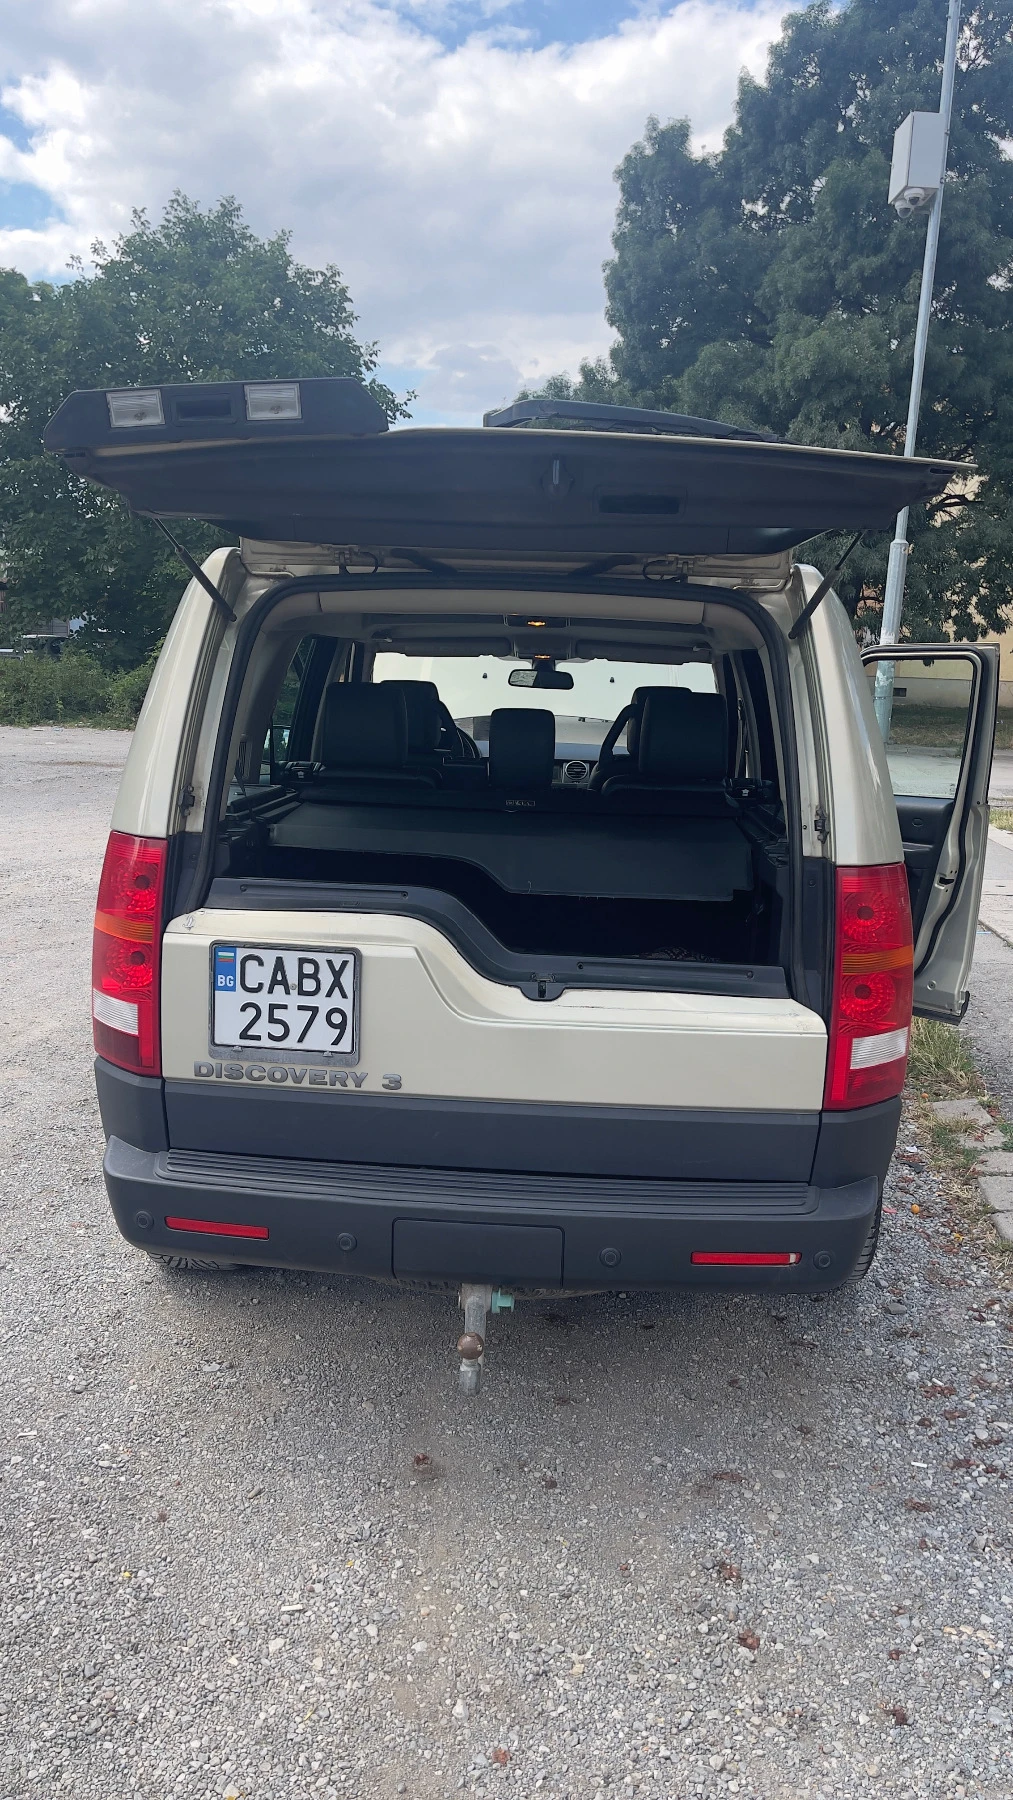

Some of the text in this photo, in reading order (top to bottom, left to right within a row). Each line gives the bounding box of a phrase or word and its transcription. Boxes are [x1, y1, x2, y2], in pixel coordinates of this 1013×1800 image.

[217, 974, 234, 987] BG
[239, 953, 349, 999] CABX
[239, 1001, 348, 1046] 2579
[193, 1060, 402, 1090] DISCOVERY 3
